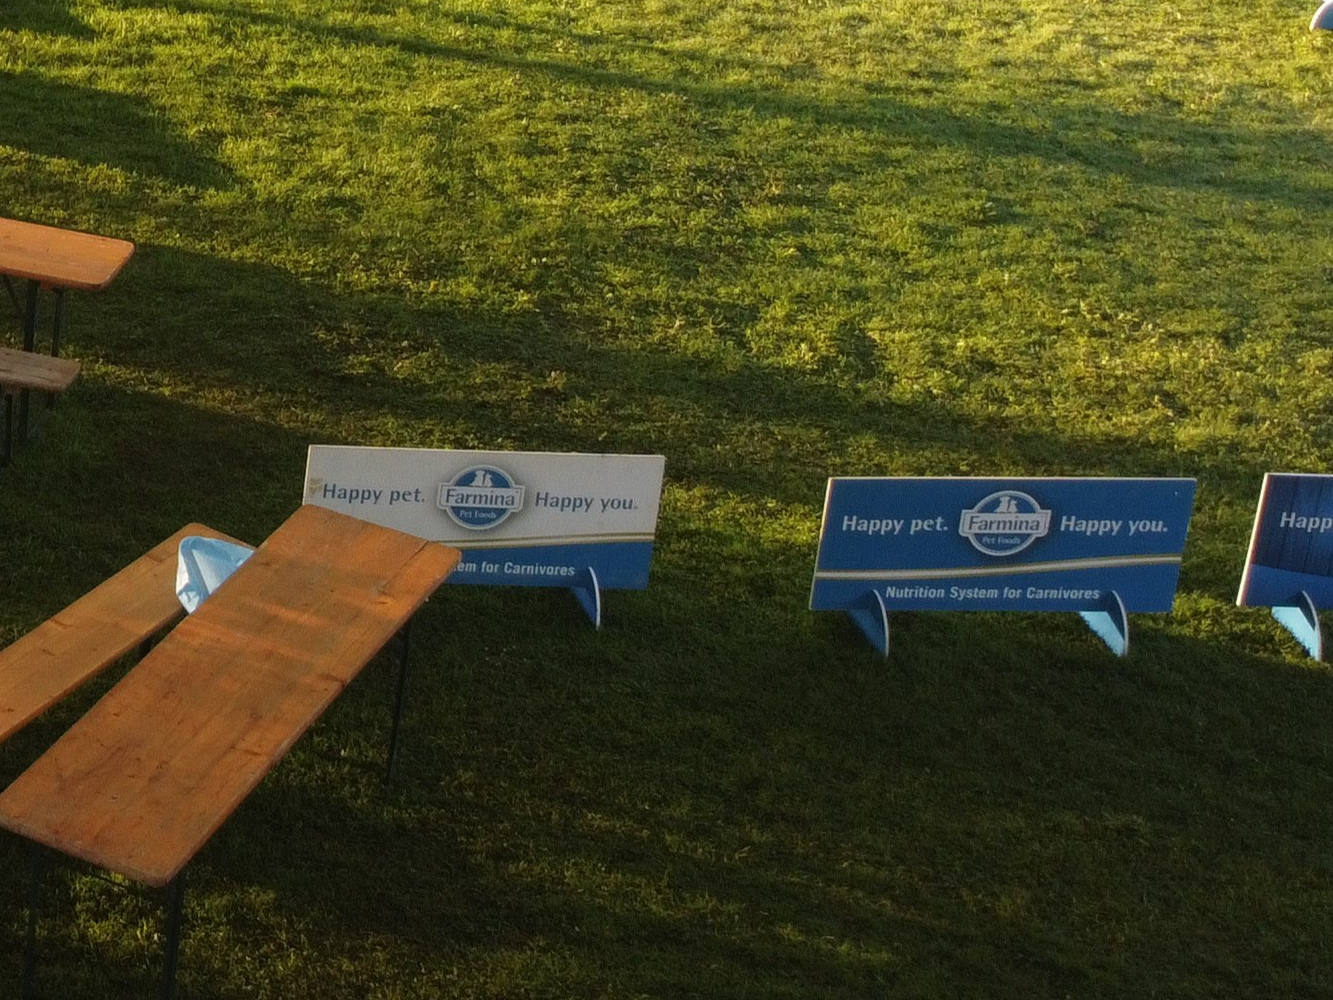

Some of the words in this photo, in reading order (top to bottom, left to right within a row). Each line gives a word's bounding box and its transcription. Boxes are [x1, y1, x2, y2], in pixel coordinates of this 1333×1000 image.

[322, 483, 383, 505] Happy
[388, 486, 426, 505] pet.
[445, 487, 516, 507] Farmina
[534, 492, 595, 512] Happy
[600, 497, 639, 514] you.
[459, 509, 473, 519] Pet
[967, 514, 1040, 532] Farmina
[1279, 511, 1333, 534] Happ
[842, 515, 904, 536] Happy
[909, 517, 949, 536] pet.
[1060, 515, 1123, 537] Happy
[1127, 520, 1169, 537] you.
[982, 536, 996, 546] Pet
[480, 561, 500, 574] for
[503, 562, 576, 577] Carnivores
[885, 585, 946, 599] Nutrition
[949, 586, 998, 601] System
[1003, 586, 1023, 599] for
[1026, 586, 1100, 601] Carnivores
